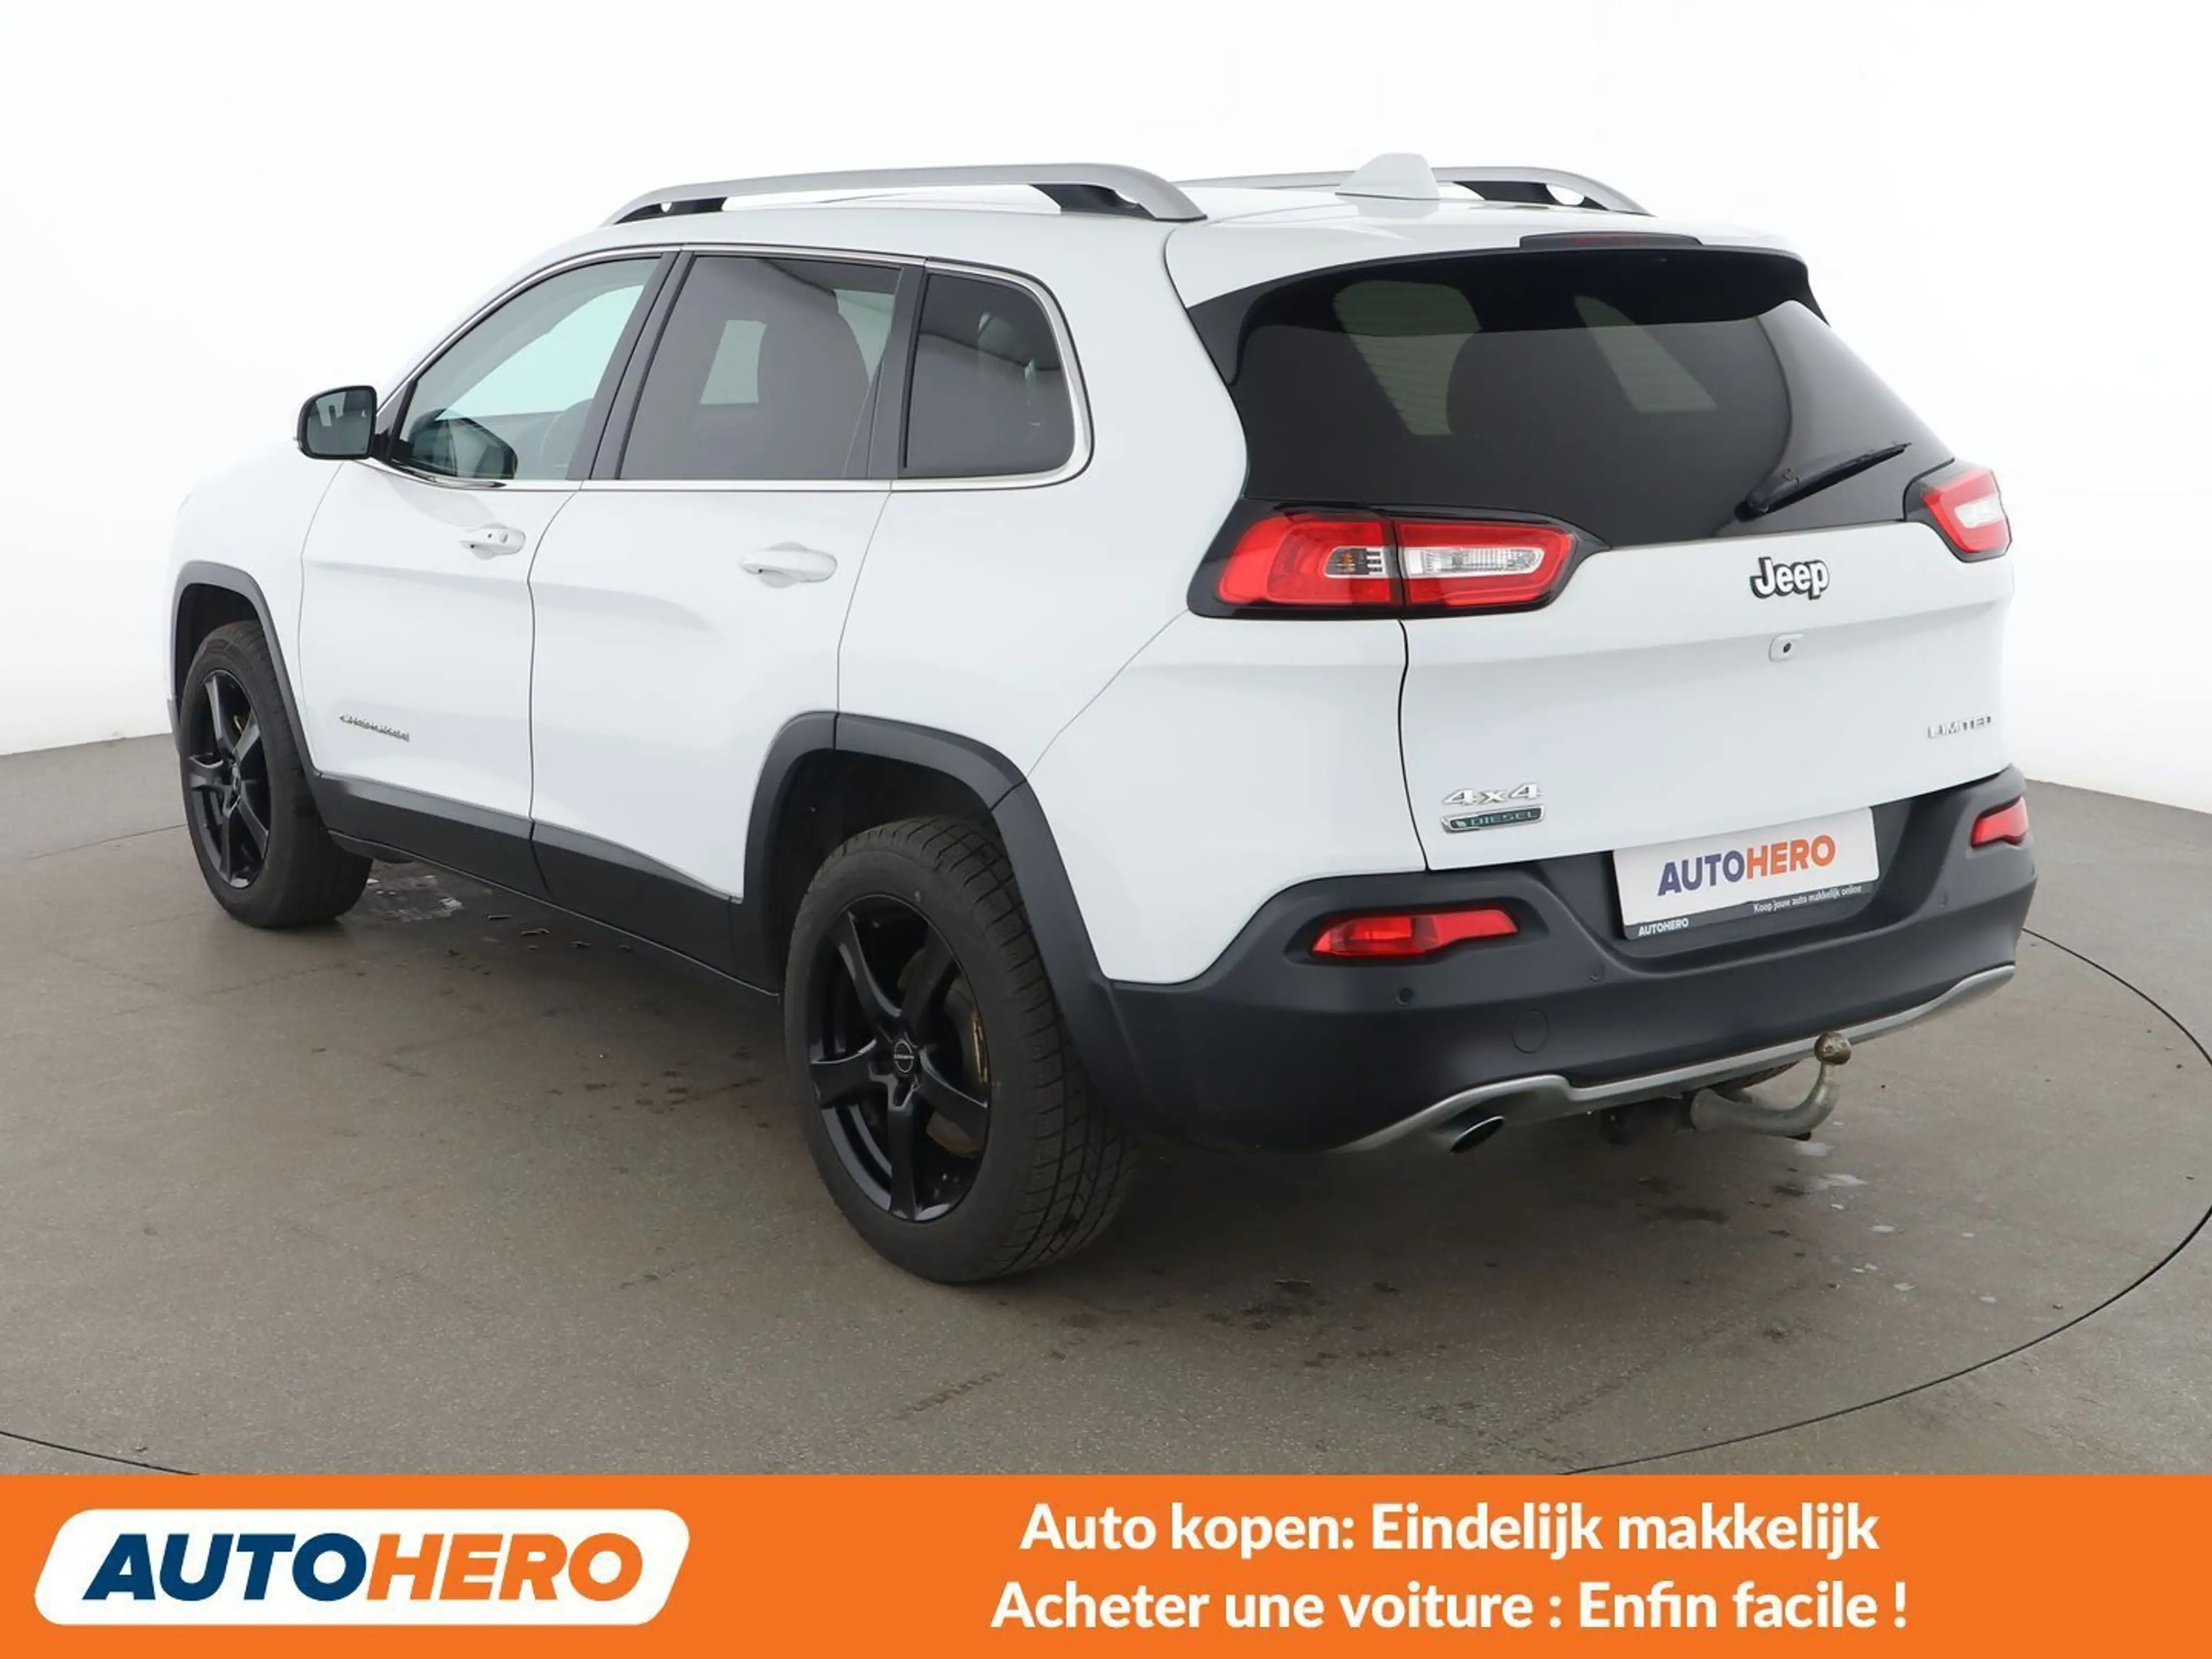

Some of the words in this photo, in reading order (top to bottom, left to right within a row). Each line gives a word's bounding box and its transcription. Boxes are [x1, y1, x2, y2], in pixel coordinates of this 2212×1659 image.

[1750, 556, 1830, 600] Jeep
[1441, 782, 1544, 806] 4x4
[1658, 835, 1836, 896] AUTOHERO
[1753, 903, 1773, 914] Koop
[1638, 917, 1689, 937] AUTOHERO
